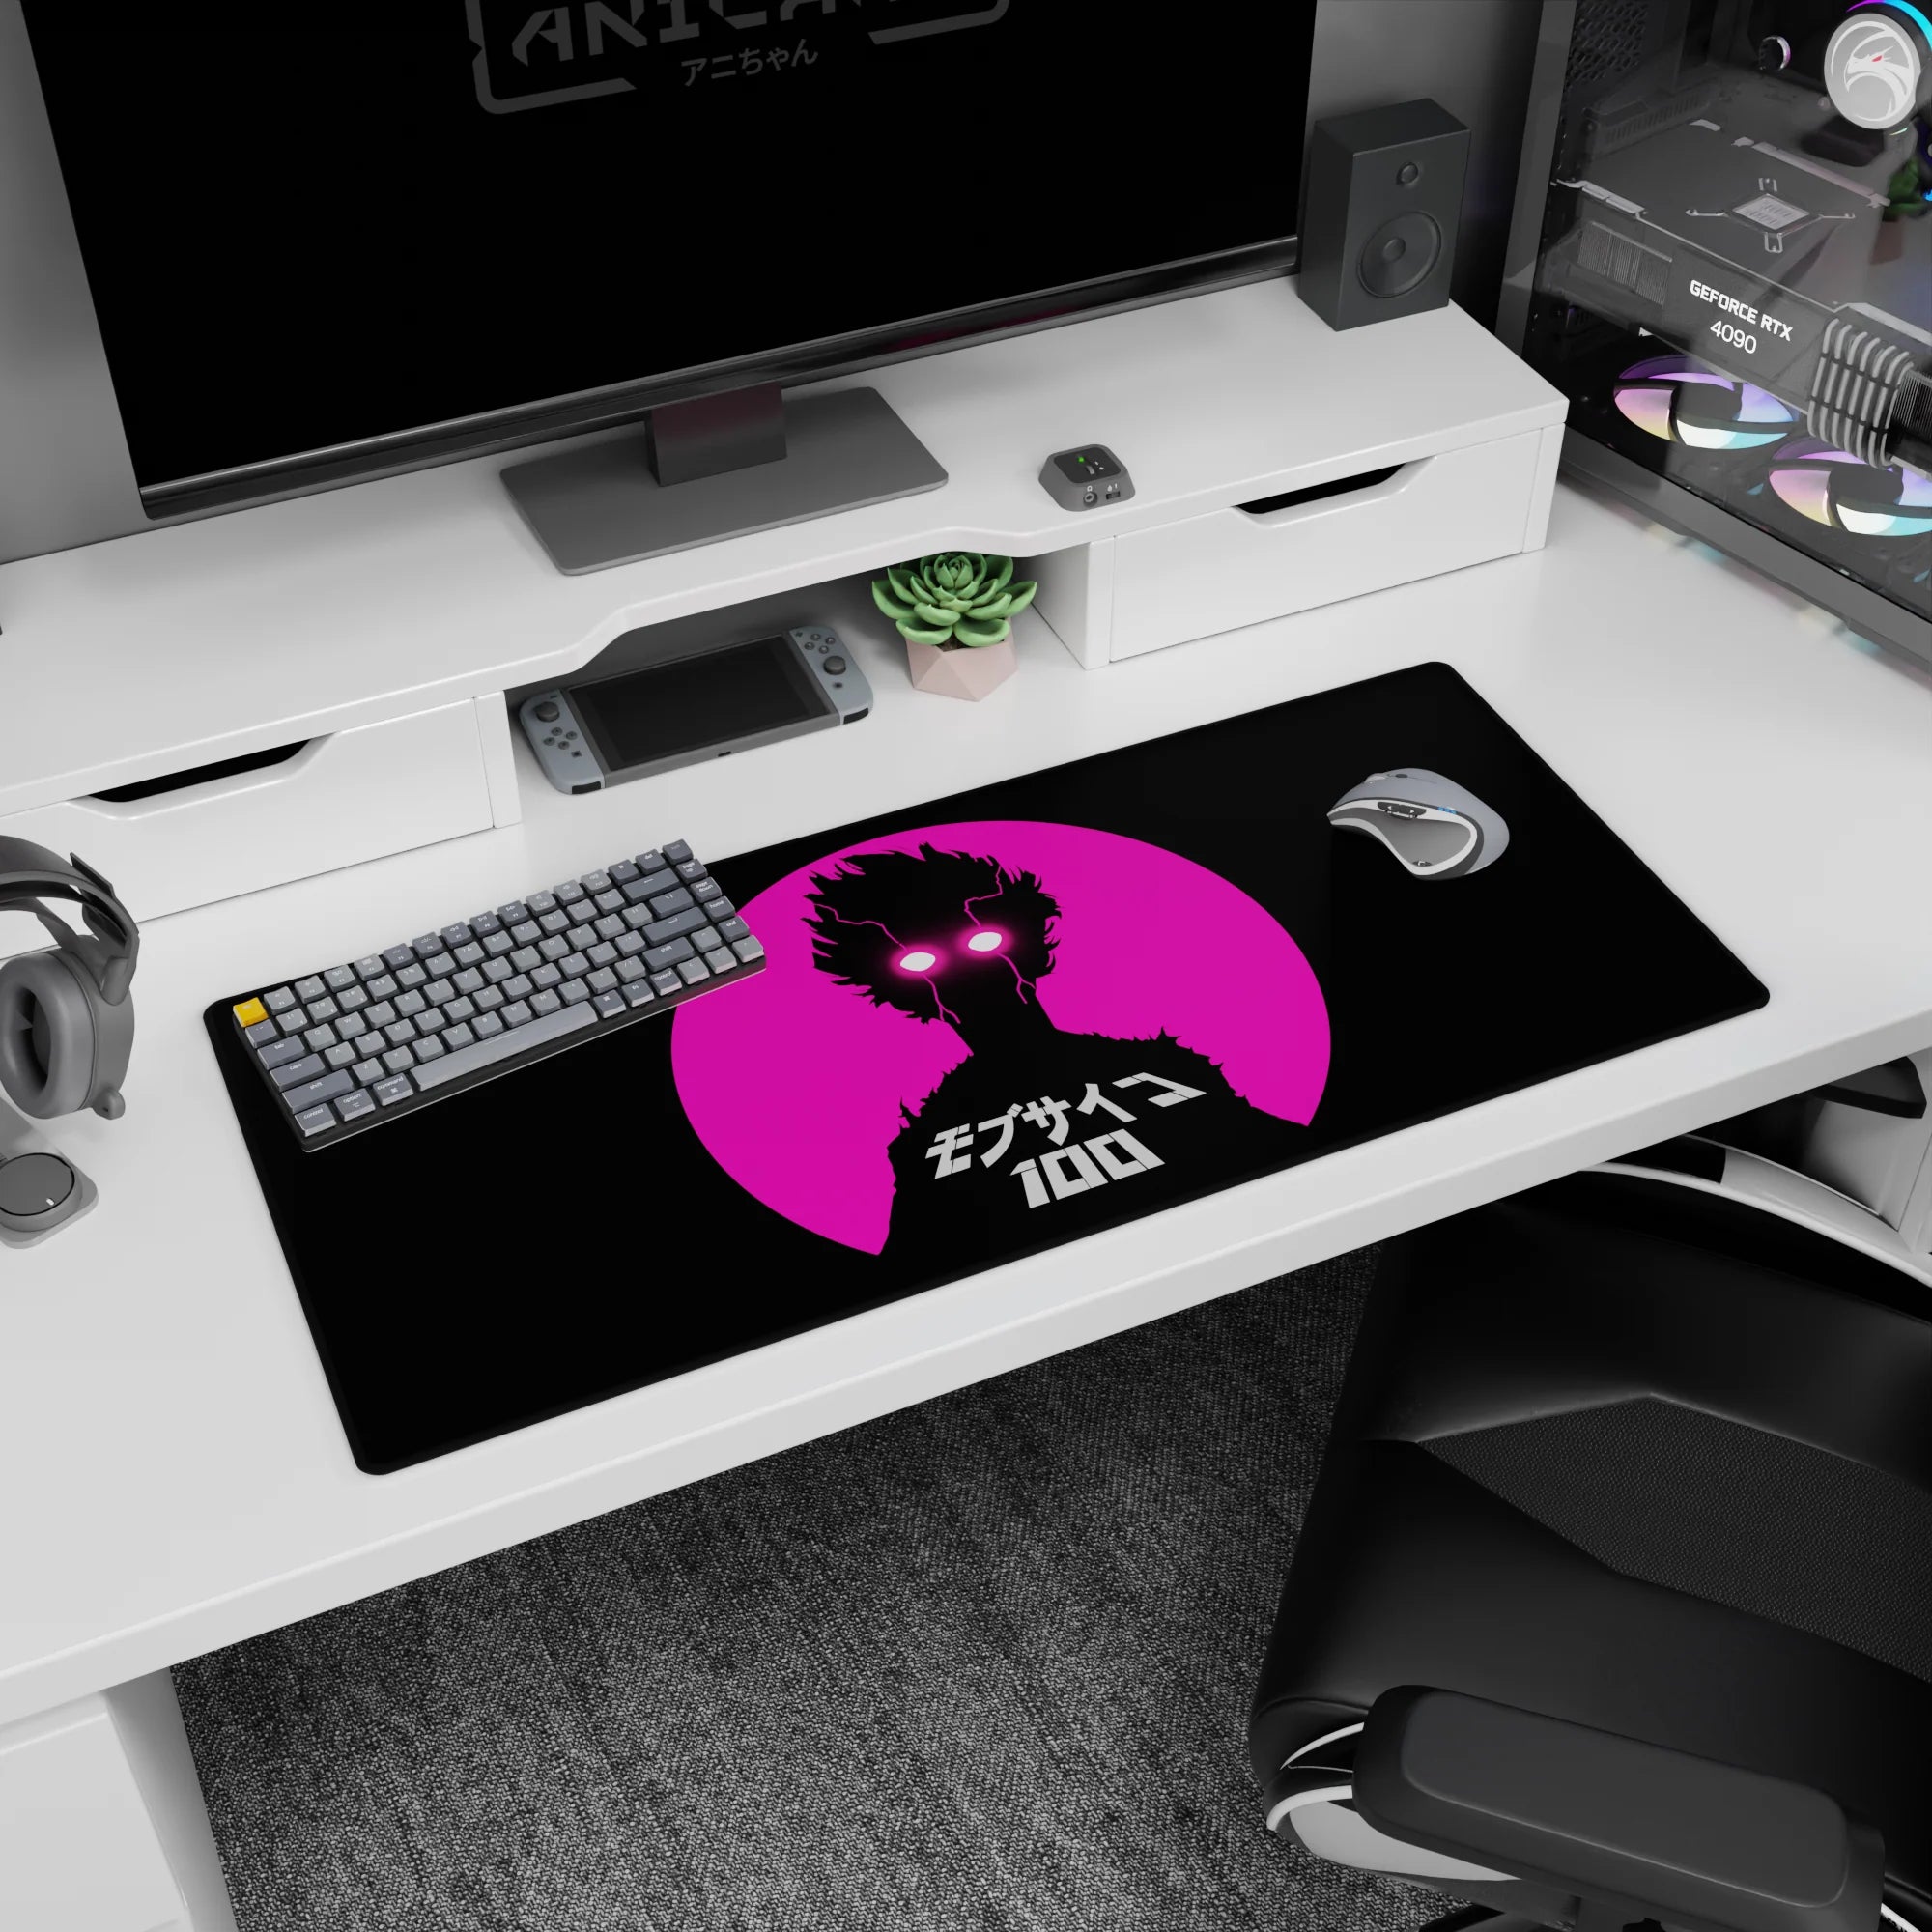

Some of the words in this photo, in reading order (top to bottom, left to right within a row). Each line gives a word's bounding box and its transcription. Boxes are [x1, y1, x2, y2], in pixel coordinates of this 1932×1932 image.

[680, 39, 819, 87] アニちゃん
[1690, 279, 1759, 325] GEFORCE
[1760, 314, 1793, 342] RTX
[1710, 320, 1757, 354] 4090
[309, 1081, 323, 1090] shift
[343, 1093, 362, 1104] option
[377, 1075, 404, 1090] command
[303, 1108, 324, 1120] control
[924, 1071, 1208, 1179] モブサイコ
[1009, 1128, 1166, 1209] 100
